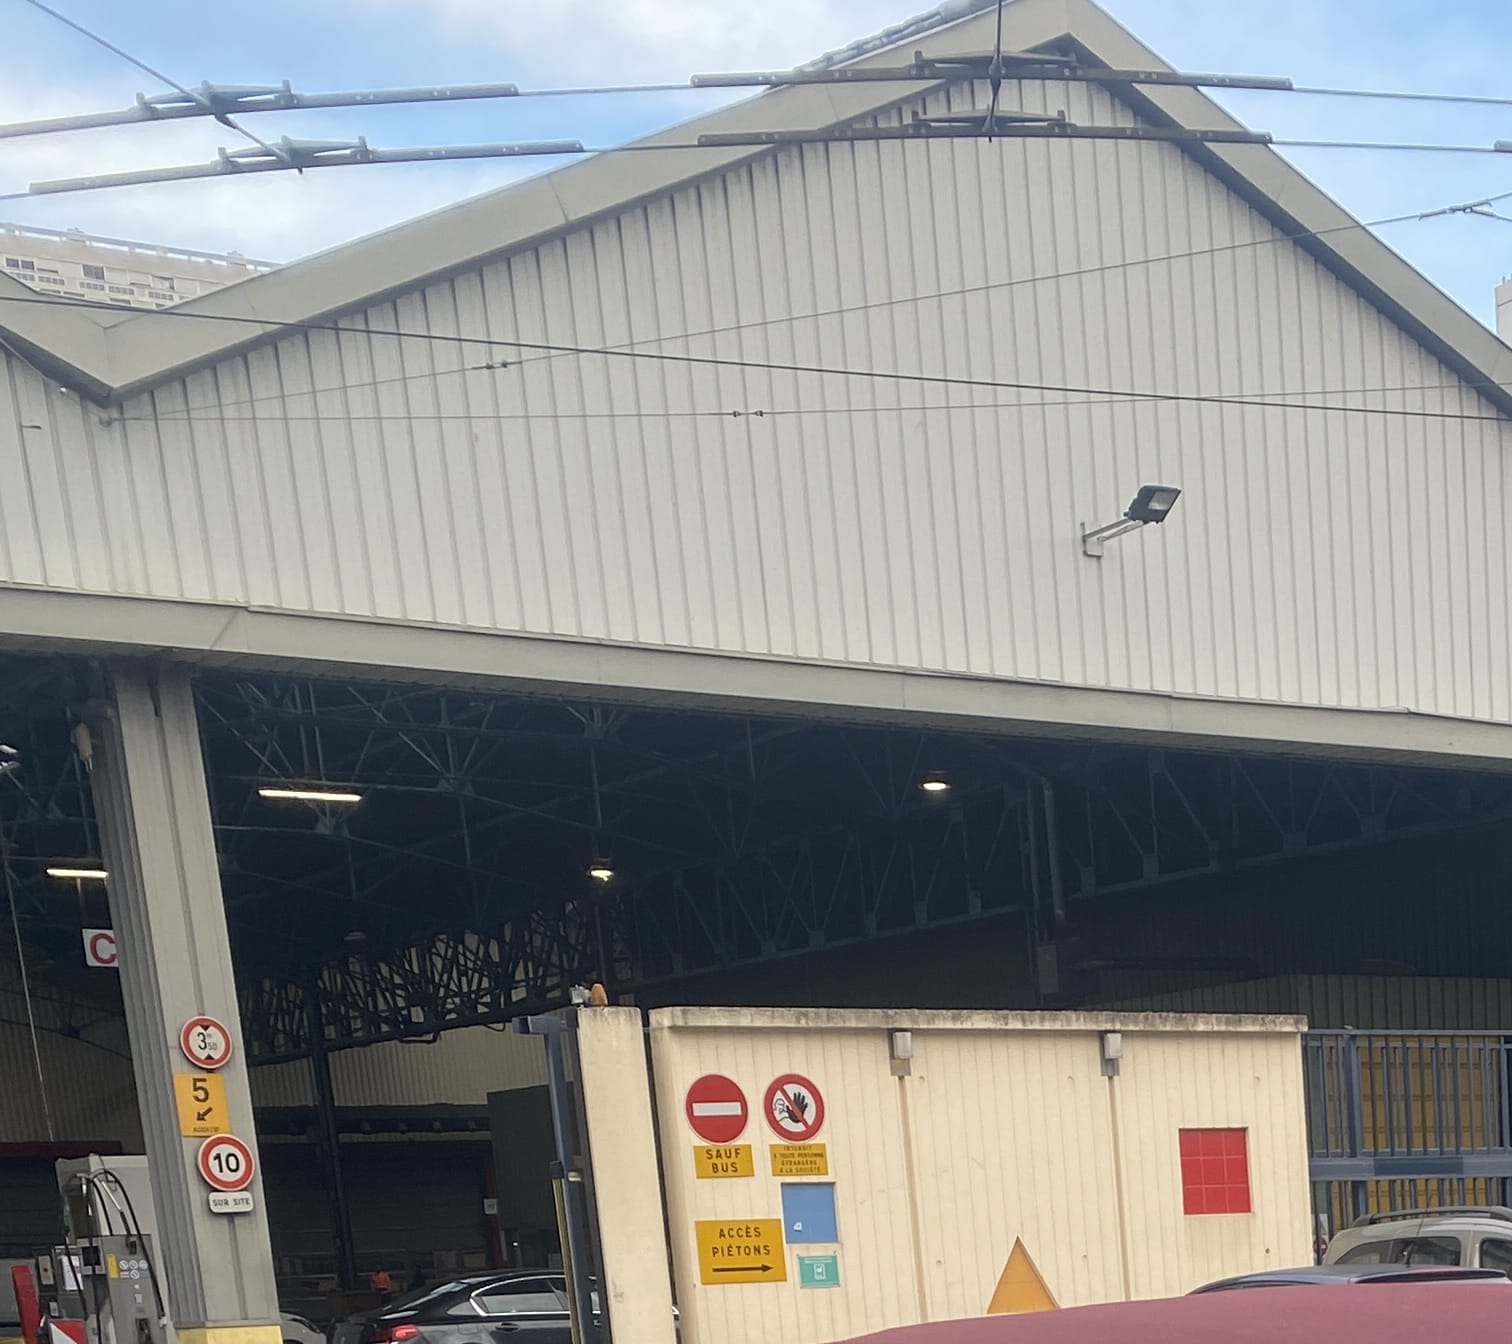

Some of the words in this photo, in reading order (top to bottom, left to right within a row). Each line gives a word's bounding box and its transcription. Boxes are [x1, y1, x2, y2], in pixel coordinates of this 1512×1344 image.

[192, 1078, 209, 1103] 5
[705, 1147, 741, 1160] SAUF
[213, 1152, 240, 1173] 10
[712, 1162, 739, 1174] BUS
[212, 1198, 229, 1207] SUR
[233, 1197, 250, 1206] SITE
[719, 1225, 761, 1239] ACCÈS
[712, 1244, 771, 1257] PIÉTONS
